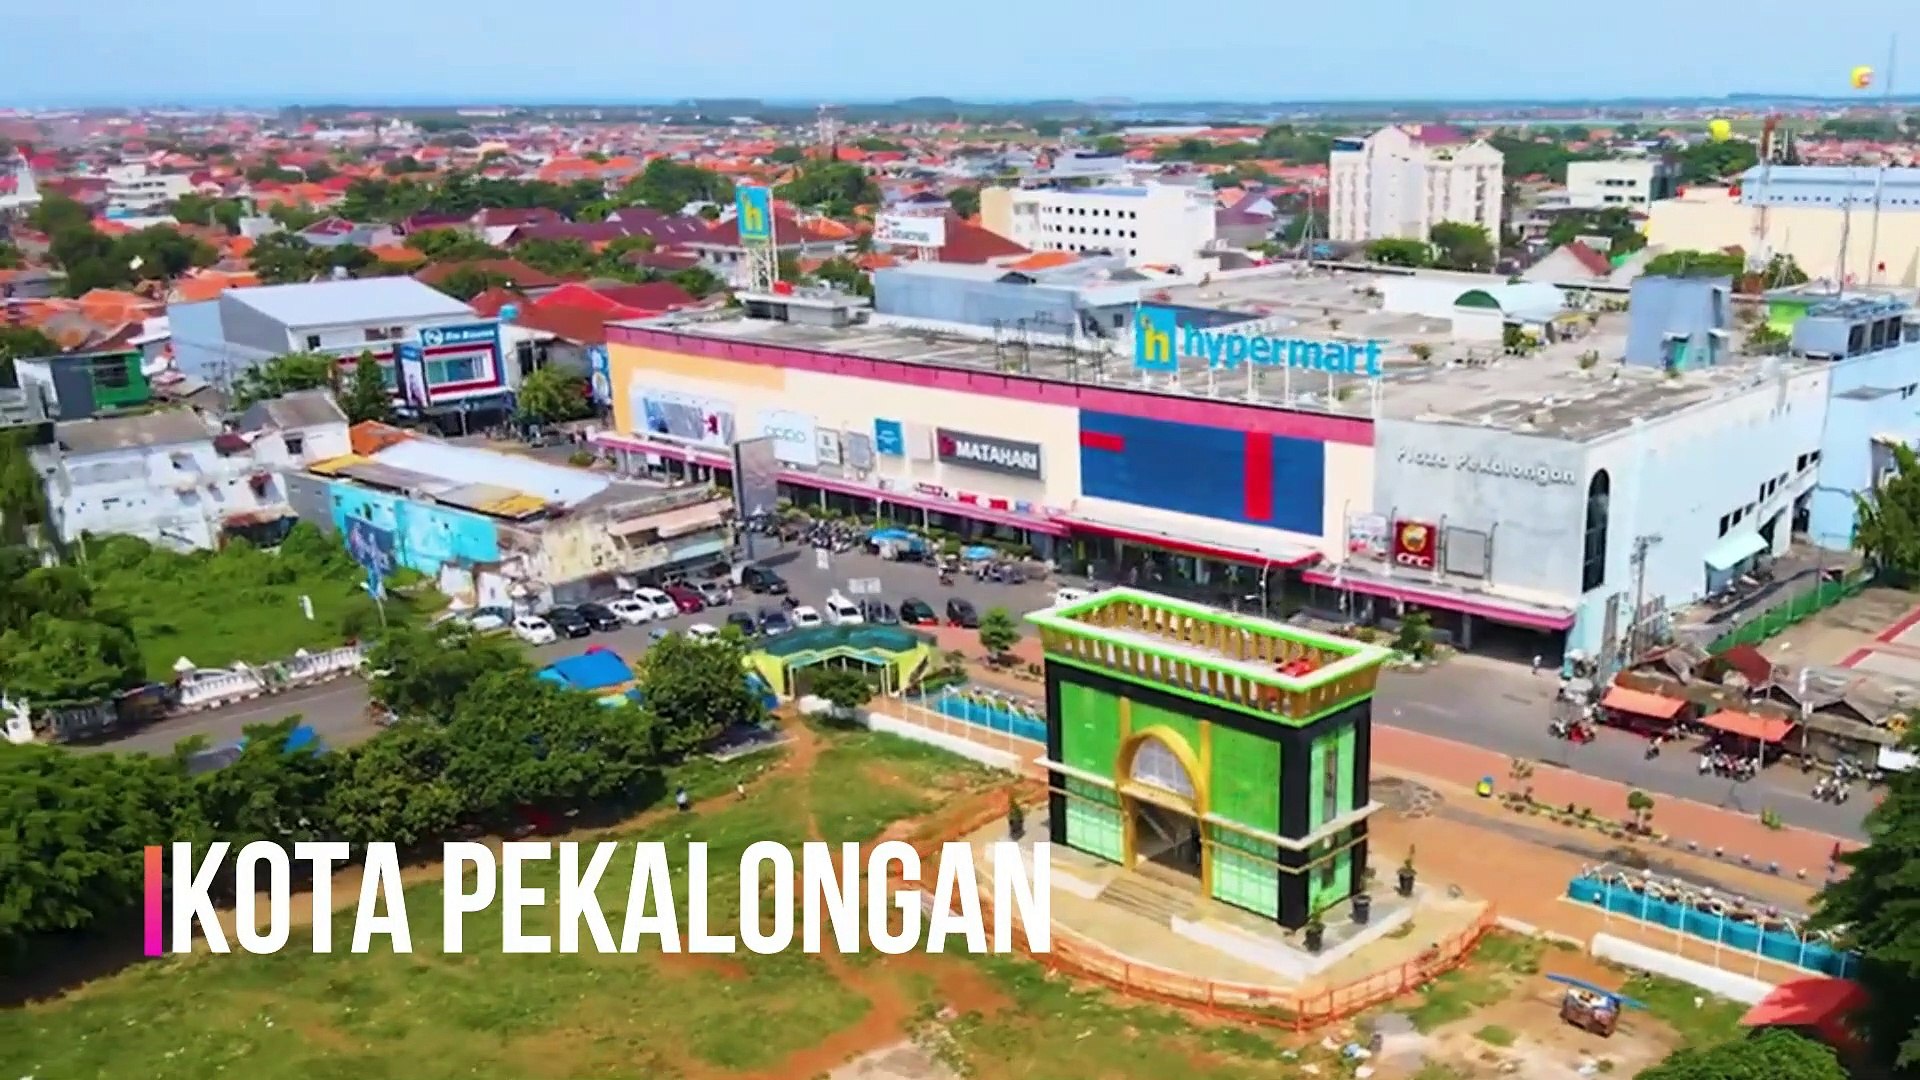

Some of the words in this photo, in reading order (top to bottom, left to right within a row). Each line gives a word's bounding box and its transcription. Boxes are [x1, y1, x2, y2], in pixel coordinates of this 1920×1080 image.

[1184, 320, 1382, 376] hypermart
[956, 440, 1037, 470] MATAHARI
[1456, 454, 1576, 487] Pekalongan
